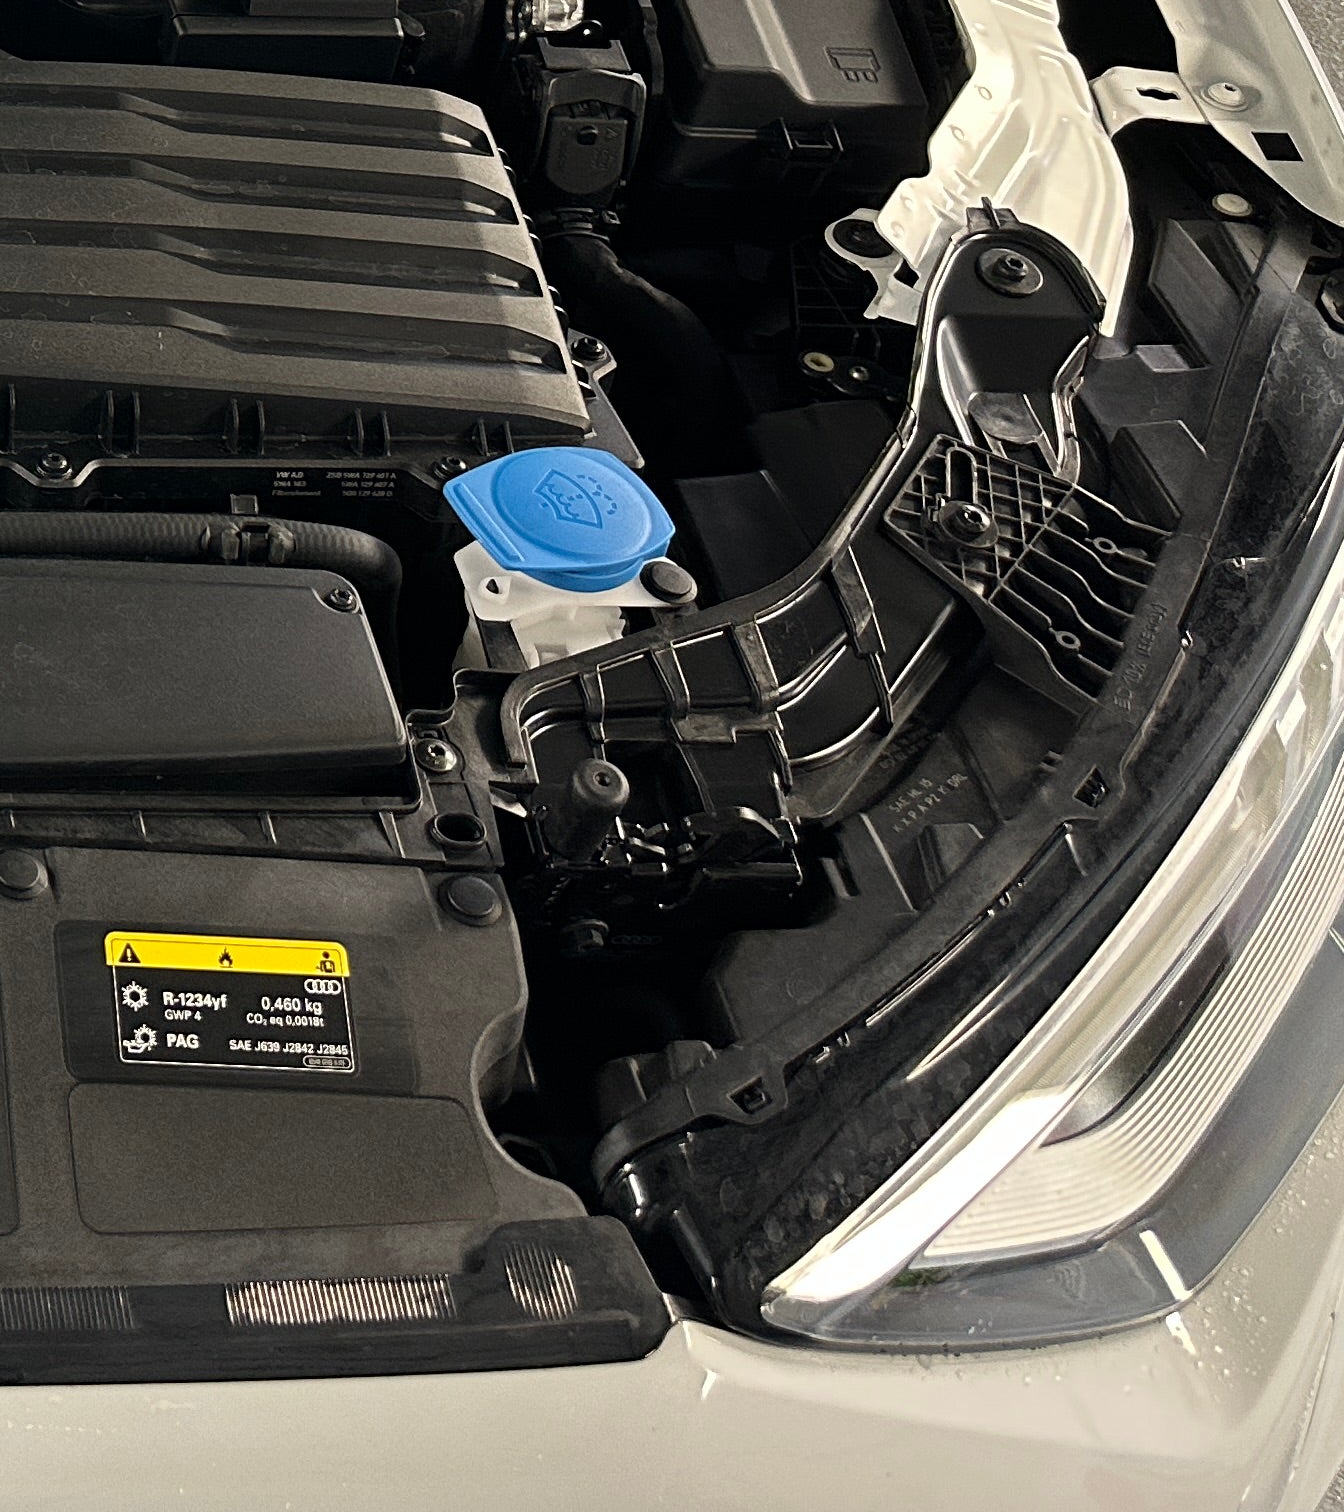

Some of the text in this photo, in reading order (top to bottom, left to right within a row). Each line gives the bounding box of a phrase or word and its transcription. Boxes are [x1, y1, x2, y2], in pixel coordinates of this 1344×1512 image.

[162, 991, 323, 1014] R-1234yf 0,460 kg
[164, 1009, 202, 1021] GWP 4
[269, 1016, 284, 1028] eq
[166, 1033, 348, 1056] PAG SAE J639 J2842 J2845
